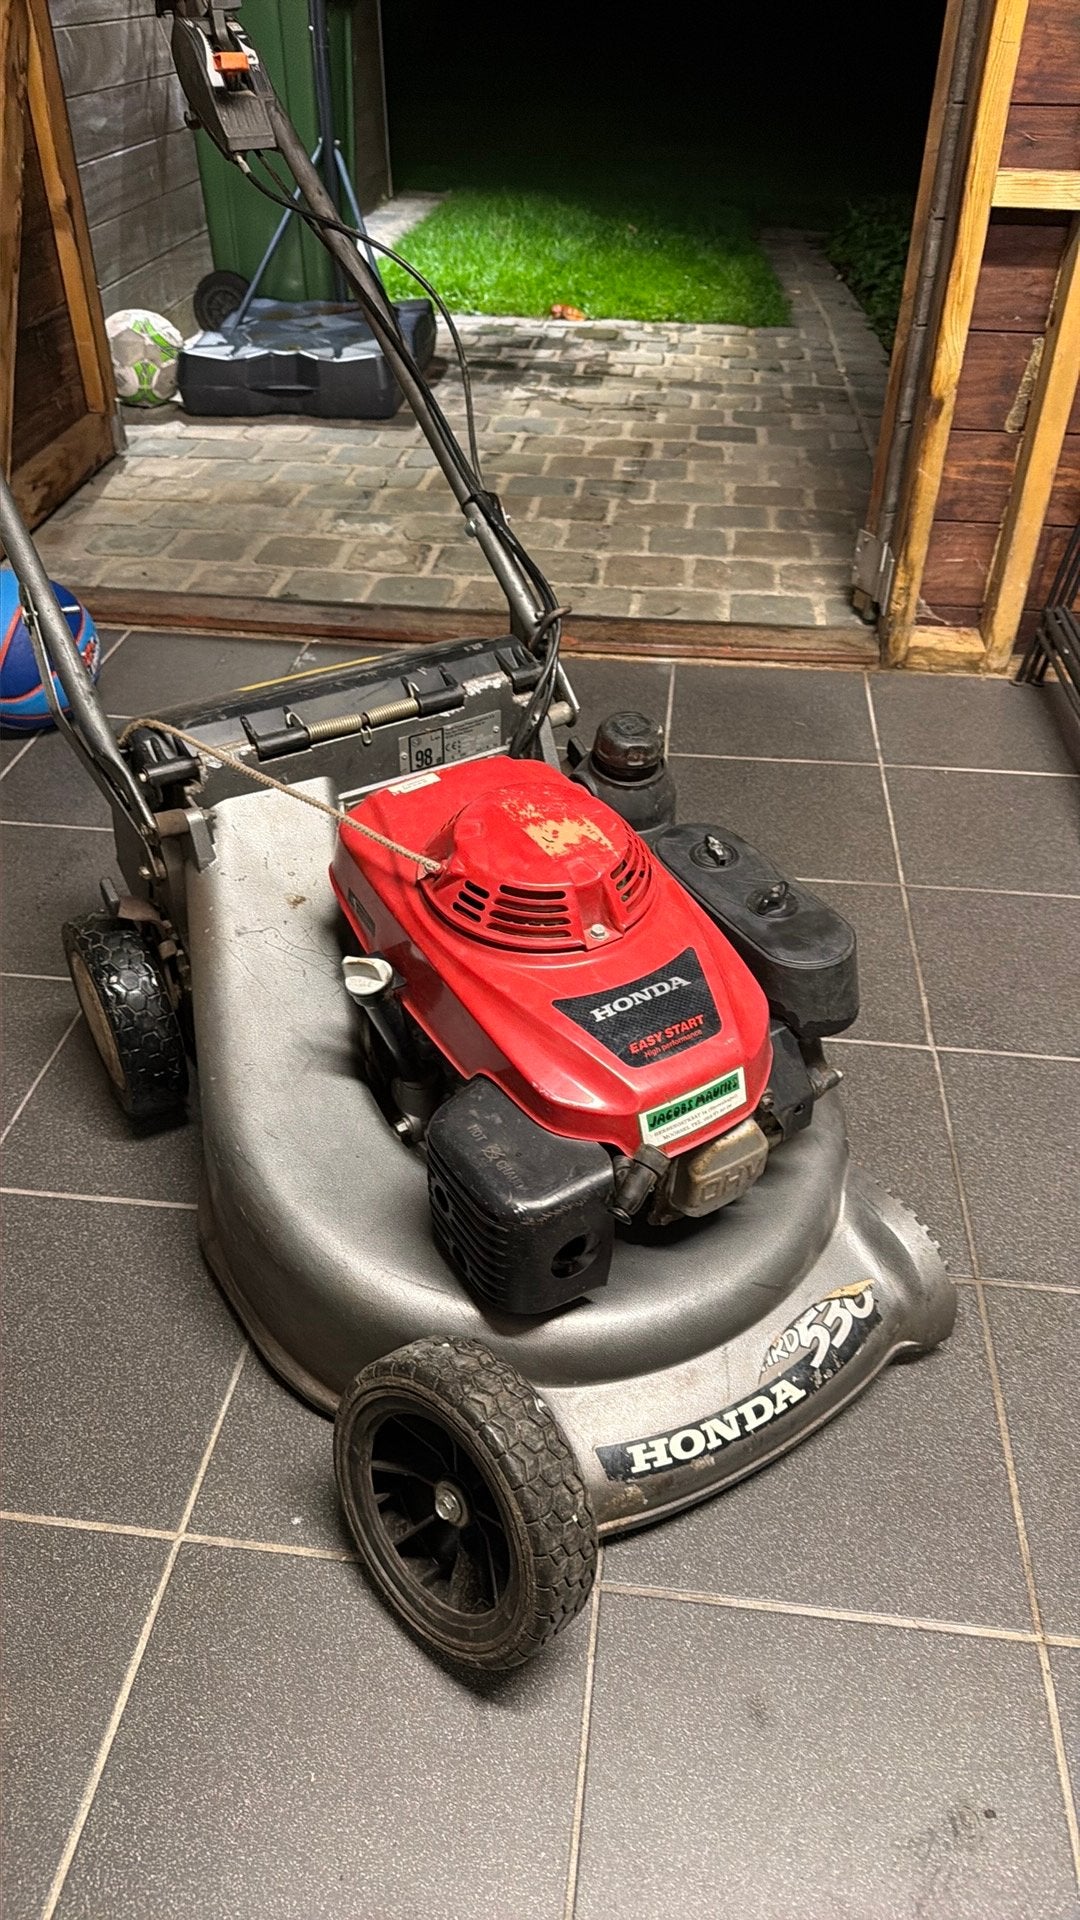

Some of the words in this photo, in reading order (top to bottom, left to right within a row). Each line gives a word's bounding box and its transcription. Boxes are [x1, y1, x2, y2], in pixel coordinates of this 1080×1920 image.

[415, 747, 433, 769] 98
[590, 975, 692, 1023] HONDA
[628, 1031, 664, 1055] EASY
[664, 1013, 705, 1039] START
[643, 1045, 661, 1059] High
[661, 1029, 703, 1055] performance
[649, 1098, 694, 1128] JACOBS
[792, 1288, 875, 1369] 530
[627, 1378, 807, 1474] HONDA
